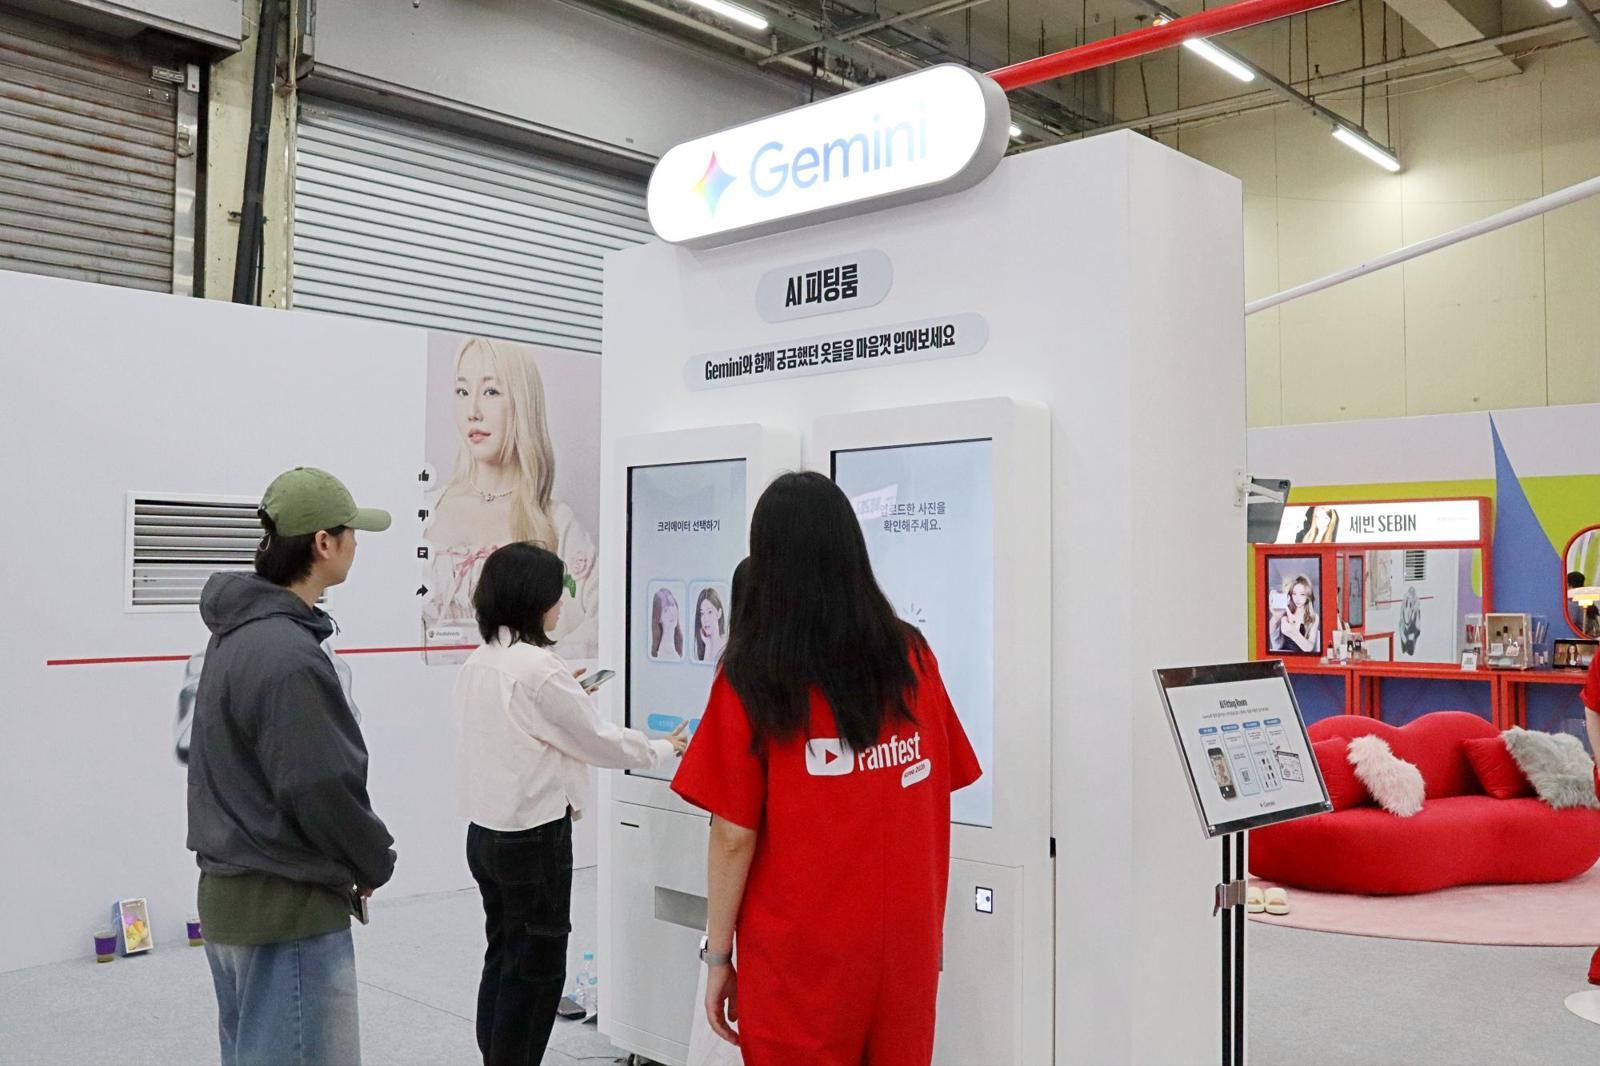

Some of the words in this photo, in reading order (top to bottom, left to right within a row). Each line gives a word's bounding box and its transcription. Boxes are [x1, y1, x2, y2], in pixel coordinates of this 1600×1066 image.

[750, 101, 927, 198] Gemini
[785, 275, 802, 307] AI
[805, 263, 858, 304] 피팅룸
[705, 354, 752, 381] Gemini와
[754, 351, 774, 373] 함께
[777, 344, 818, 370] 궁금했던
[821, 339, 854, 364] 옷들을
[856, 333, 891, 358] 마음껏
[893, 324, 955, 354] 입어보세요
[918, 501, 946, 515] 사진을
[657, 520, 690, 532] 크리에이터
[692, 519, 720, 532] 선택하기
[883, 518, 941, 532] 확인해주세요.
[1349, 515, 1375, 534] 세빈
[1378, 514, 1417, 532] SEBIN
